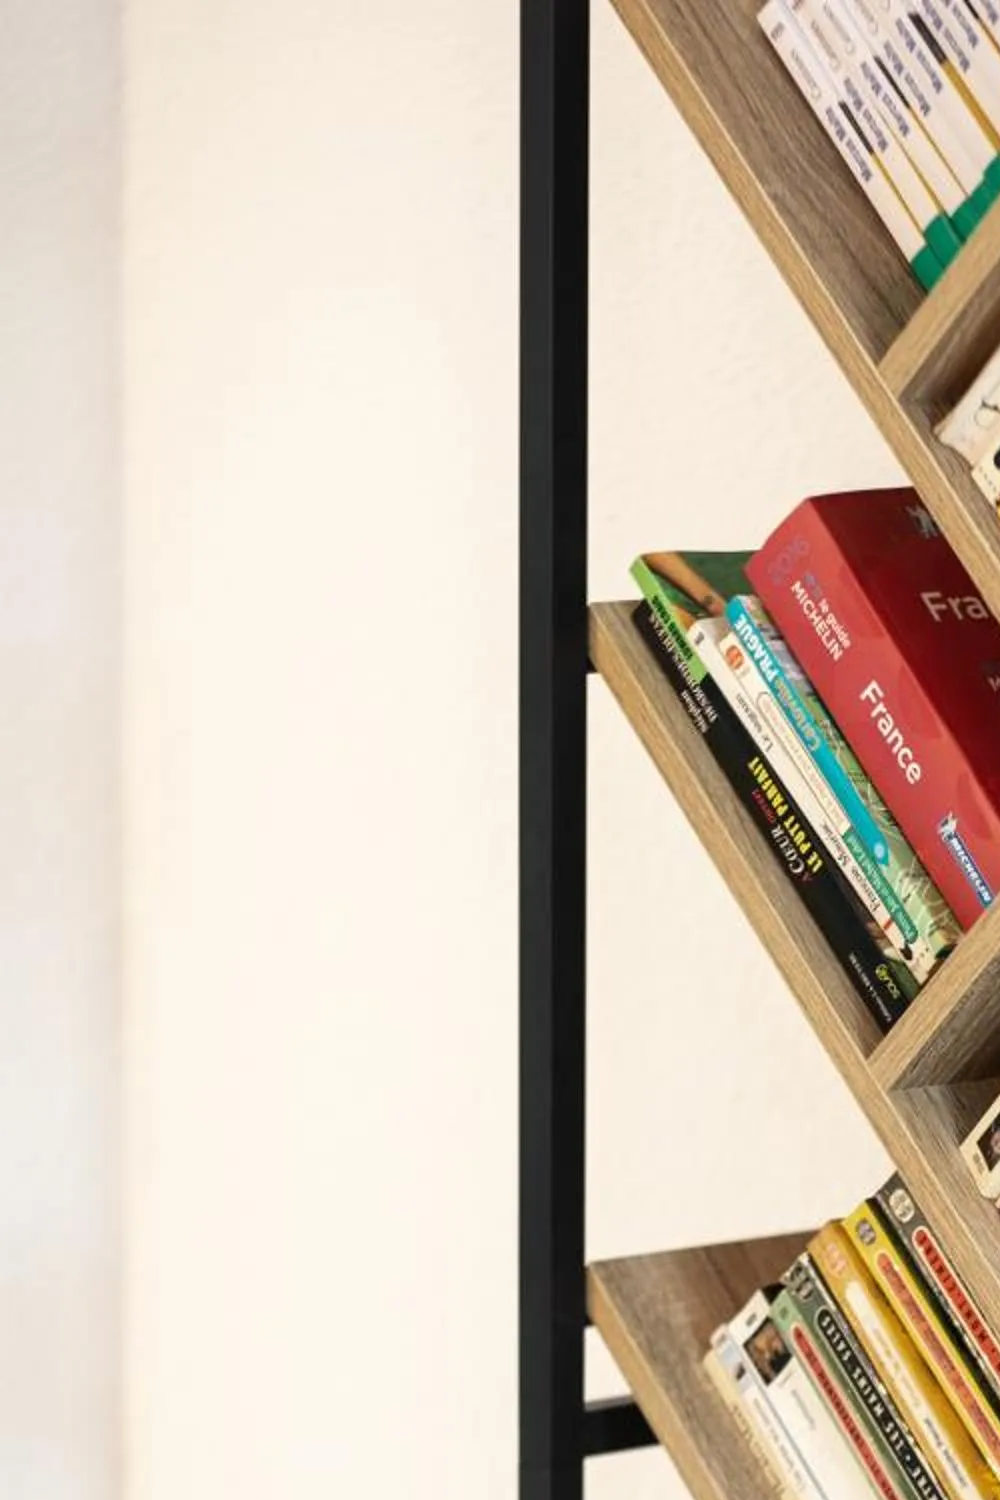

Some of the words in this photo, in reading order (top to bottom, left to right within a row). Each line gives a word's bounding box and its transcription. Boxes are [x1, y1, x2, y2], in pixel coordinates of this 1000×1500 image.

[729, 611, 781, 682] PRAGUE
[787, 578, 847, 662] MICHELIN
[822, 609, 855, 651] guide
[852, 679, 933, 787] France
[745, 755, 790, 817] PARFAIT
[767, 823, 807, 876] CŒUR
[780, 814, 813, 855] PUTT
[802, 850, 824, 873] LE
[949, 835, 992, 904] MICHELIN
[817, 1311, 856, 1363] SALES
[847, 1363, 888, 1419] MAINS
